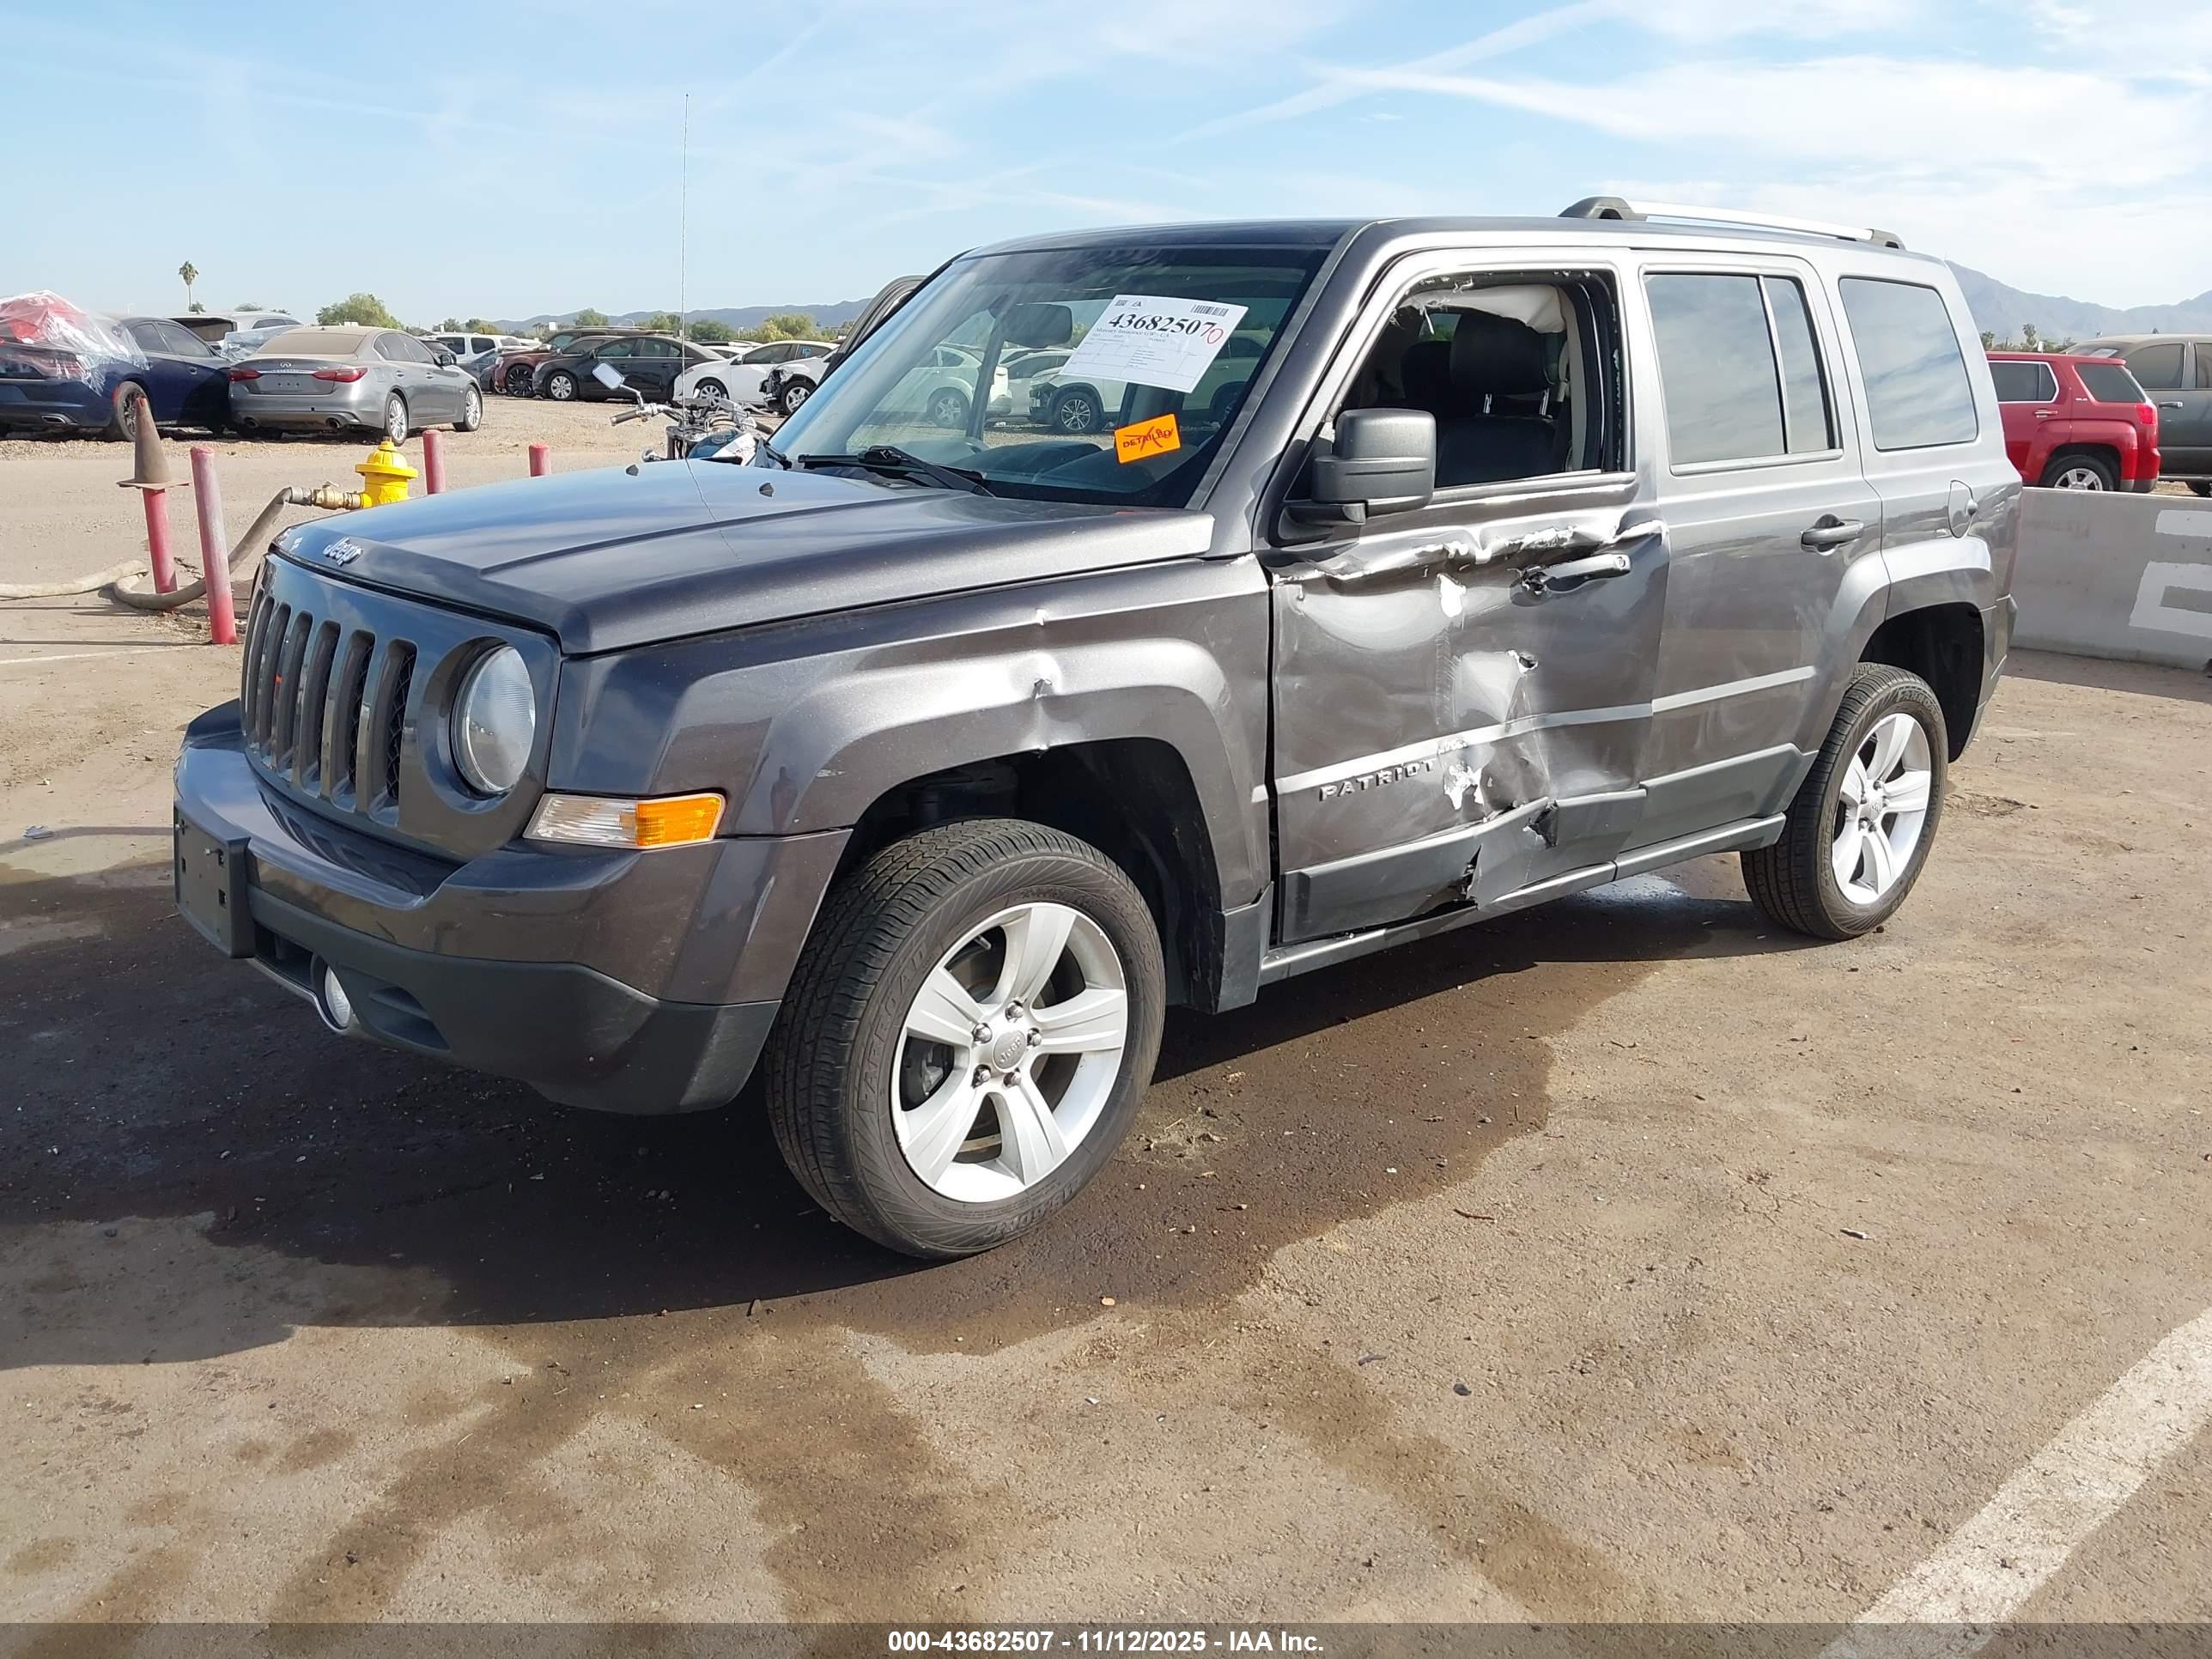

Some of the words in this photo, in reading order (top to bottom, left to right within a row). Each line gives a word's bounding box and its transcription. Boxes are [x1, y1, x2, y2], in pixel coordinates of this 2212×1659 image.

[1109, 313, 1218, 337] 43682507
[323, 537, 362, 567] Jeep
[1319, 757, 1437, 802] PATRIOT
[999, 1036, 1021, 1064] Jeep
